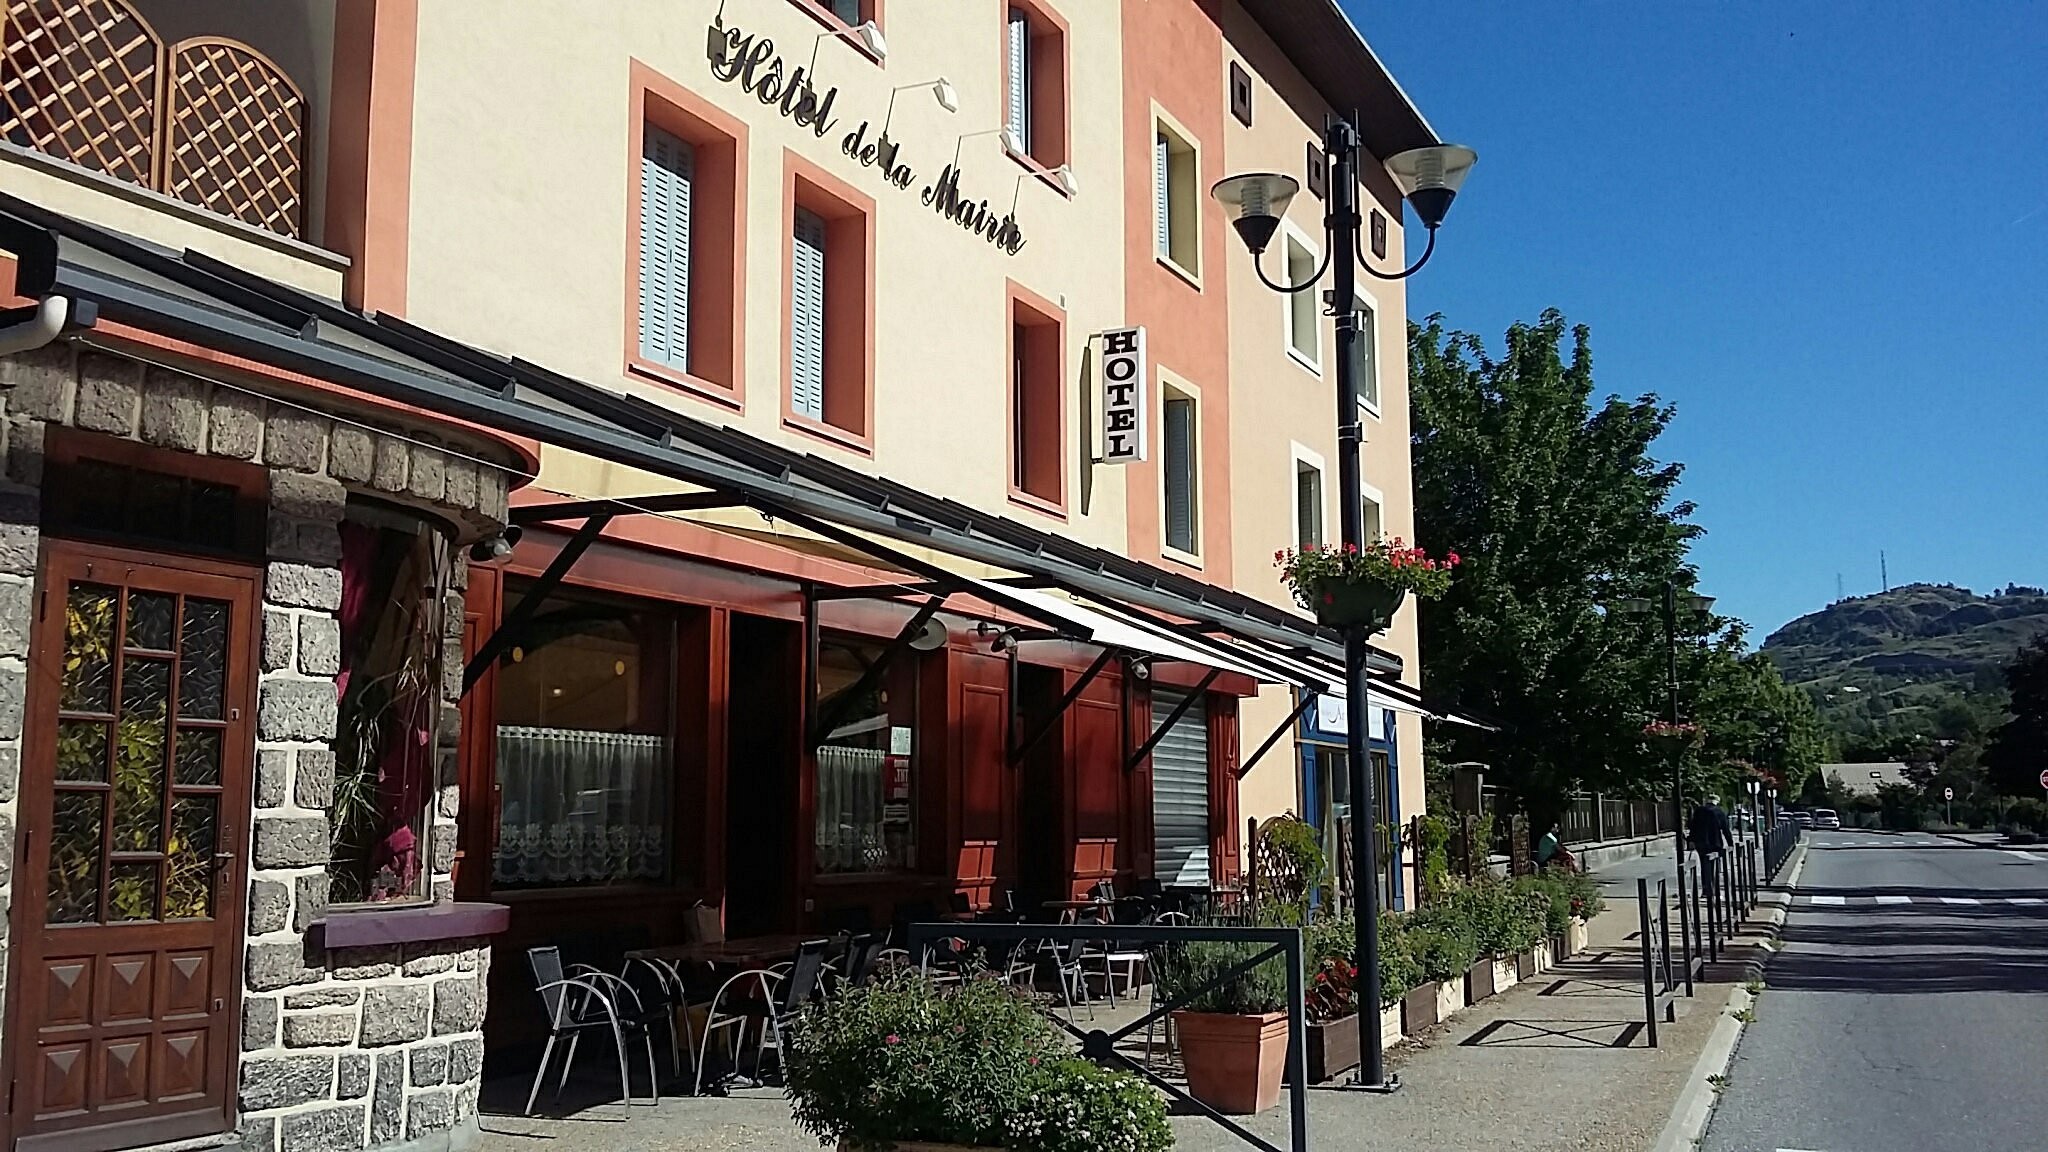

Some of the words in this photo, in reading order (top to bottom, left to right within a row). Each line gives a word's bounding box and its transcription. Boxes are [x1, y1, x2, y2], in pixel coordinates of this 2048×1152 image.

[711, 28, 839, 138] Hôtel
[842, 121, 879, 167] de
[883, 143, 917, 191] la
[921, 164, 1028, 256] Mairie
[1103, 330, 1138, 458] HOTEL
